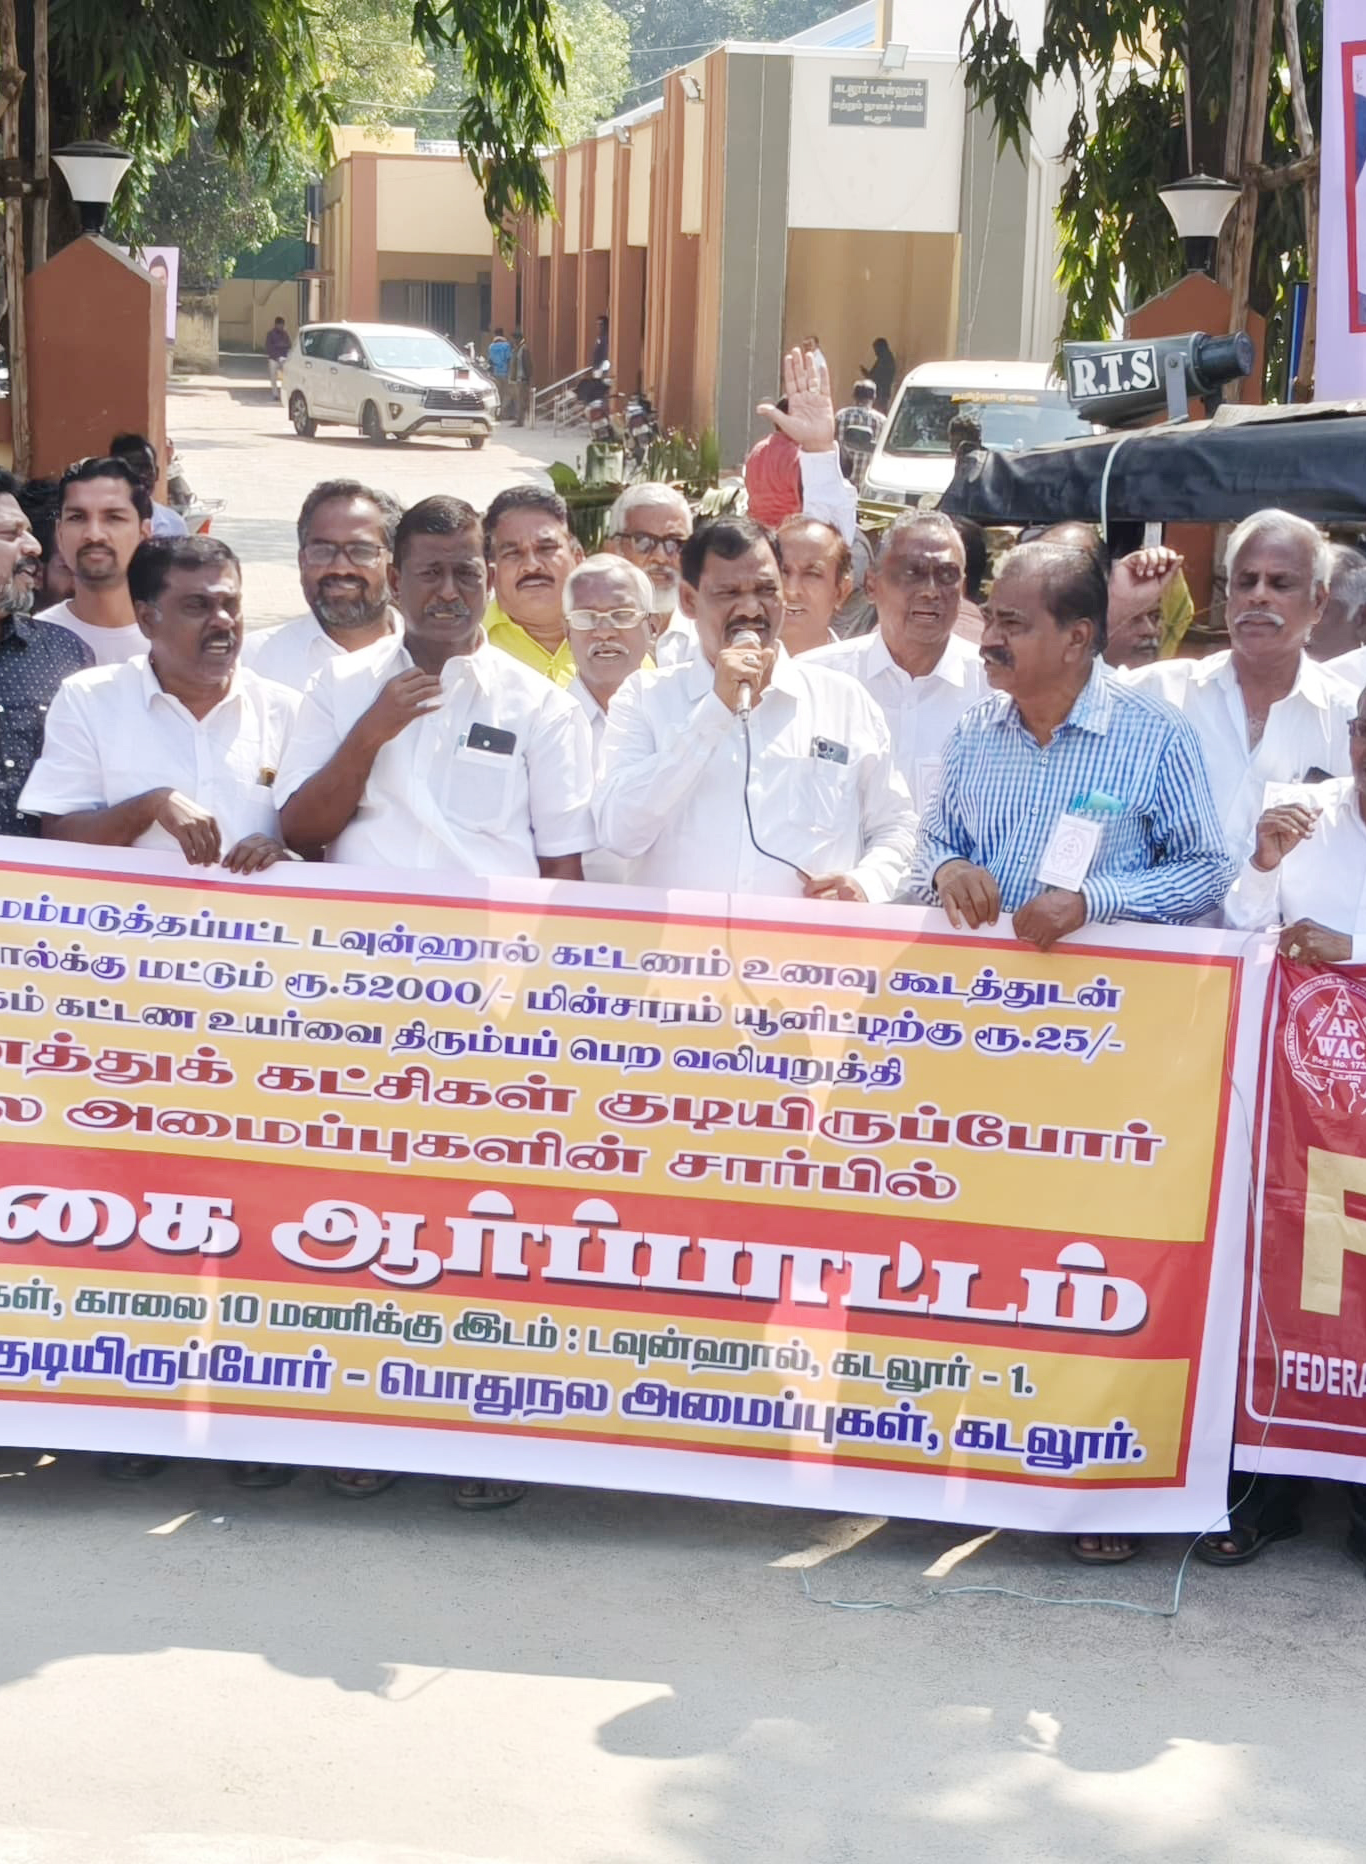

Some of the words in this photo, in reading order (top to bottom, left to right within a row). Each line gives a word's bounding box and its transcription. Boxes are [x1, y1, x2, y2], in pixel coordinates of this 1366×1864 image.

[1072, 350, 1154, 398] R.T.S
[139, 960, 274, 990] மட்டும்
[285, 972, 515, 1013] ரூ.52000/-
[526, 984, 722, 1025] மின்சாரம்
[734, 1003, 963, 1046] யூனிட்டிற்கு
[974, 1023, 1124, 1060] ரூ.25/-
[312, 924, 540, 963] டவுன்ஹால்
[552, 945, 731, 979] கட்டணம்
[742, 958, 877, 994] உணவு
[889, 968, 1121, 1009] கூடத்துடன்
[1336, 1000, 1349, 1017] F
[56, 998, 198, 1031] கட்டண
[208, 1009, 383, 1045] உயர்வை
[391, 1021, 558, 1058] திரும்பப்
[570, 1038, 663, 1071] பெற
[672, 1044, 903, 1088] வலியுறுத்தி
[1315, 1035, 1366, 1060] WAC
[1326, 1016, 1360, 1039] AR
[65, 1099, 648, 1174] அமைப்புகளின்
[668, 1150, 956, 1199] சார்பில்
[257, 1064, 577, 1113] கட்சிகள்
[598, 1092, 1162, 1161] குடியிருப்போர்
[271, 1190, 1149, 1334] ஆர்ப்பாட்டம்
[75, 1287, 207, 1318] காலை
[219, 1294, 259, 1323] 10
[269, 1302, 442, 1343] மணிக்கு
[454, 1311, 558, 1350] இடம்
[588, 1328, 821, 1378] டவுன்ஹால்,
[831, 1355, 972, 1392] கடலூர்
[1011, 1365, 1033, 1394] 1.
[380, 1361, 609, 1417] பொதுநல
[622, 1381, 939, 1451] அமைப்புகள்,
[953, 1421, 1142, 1470] கடலூர்.
